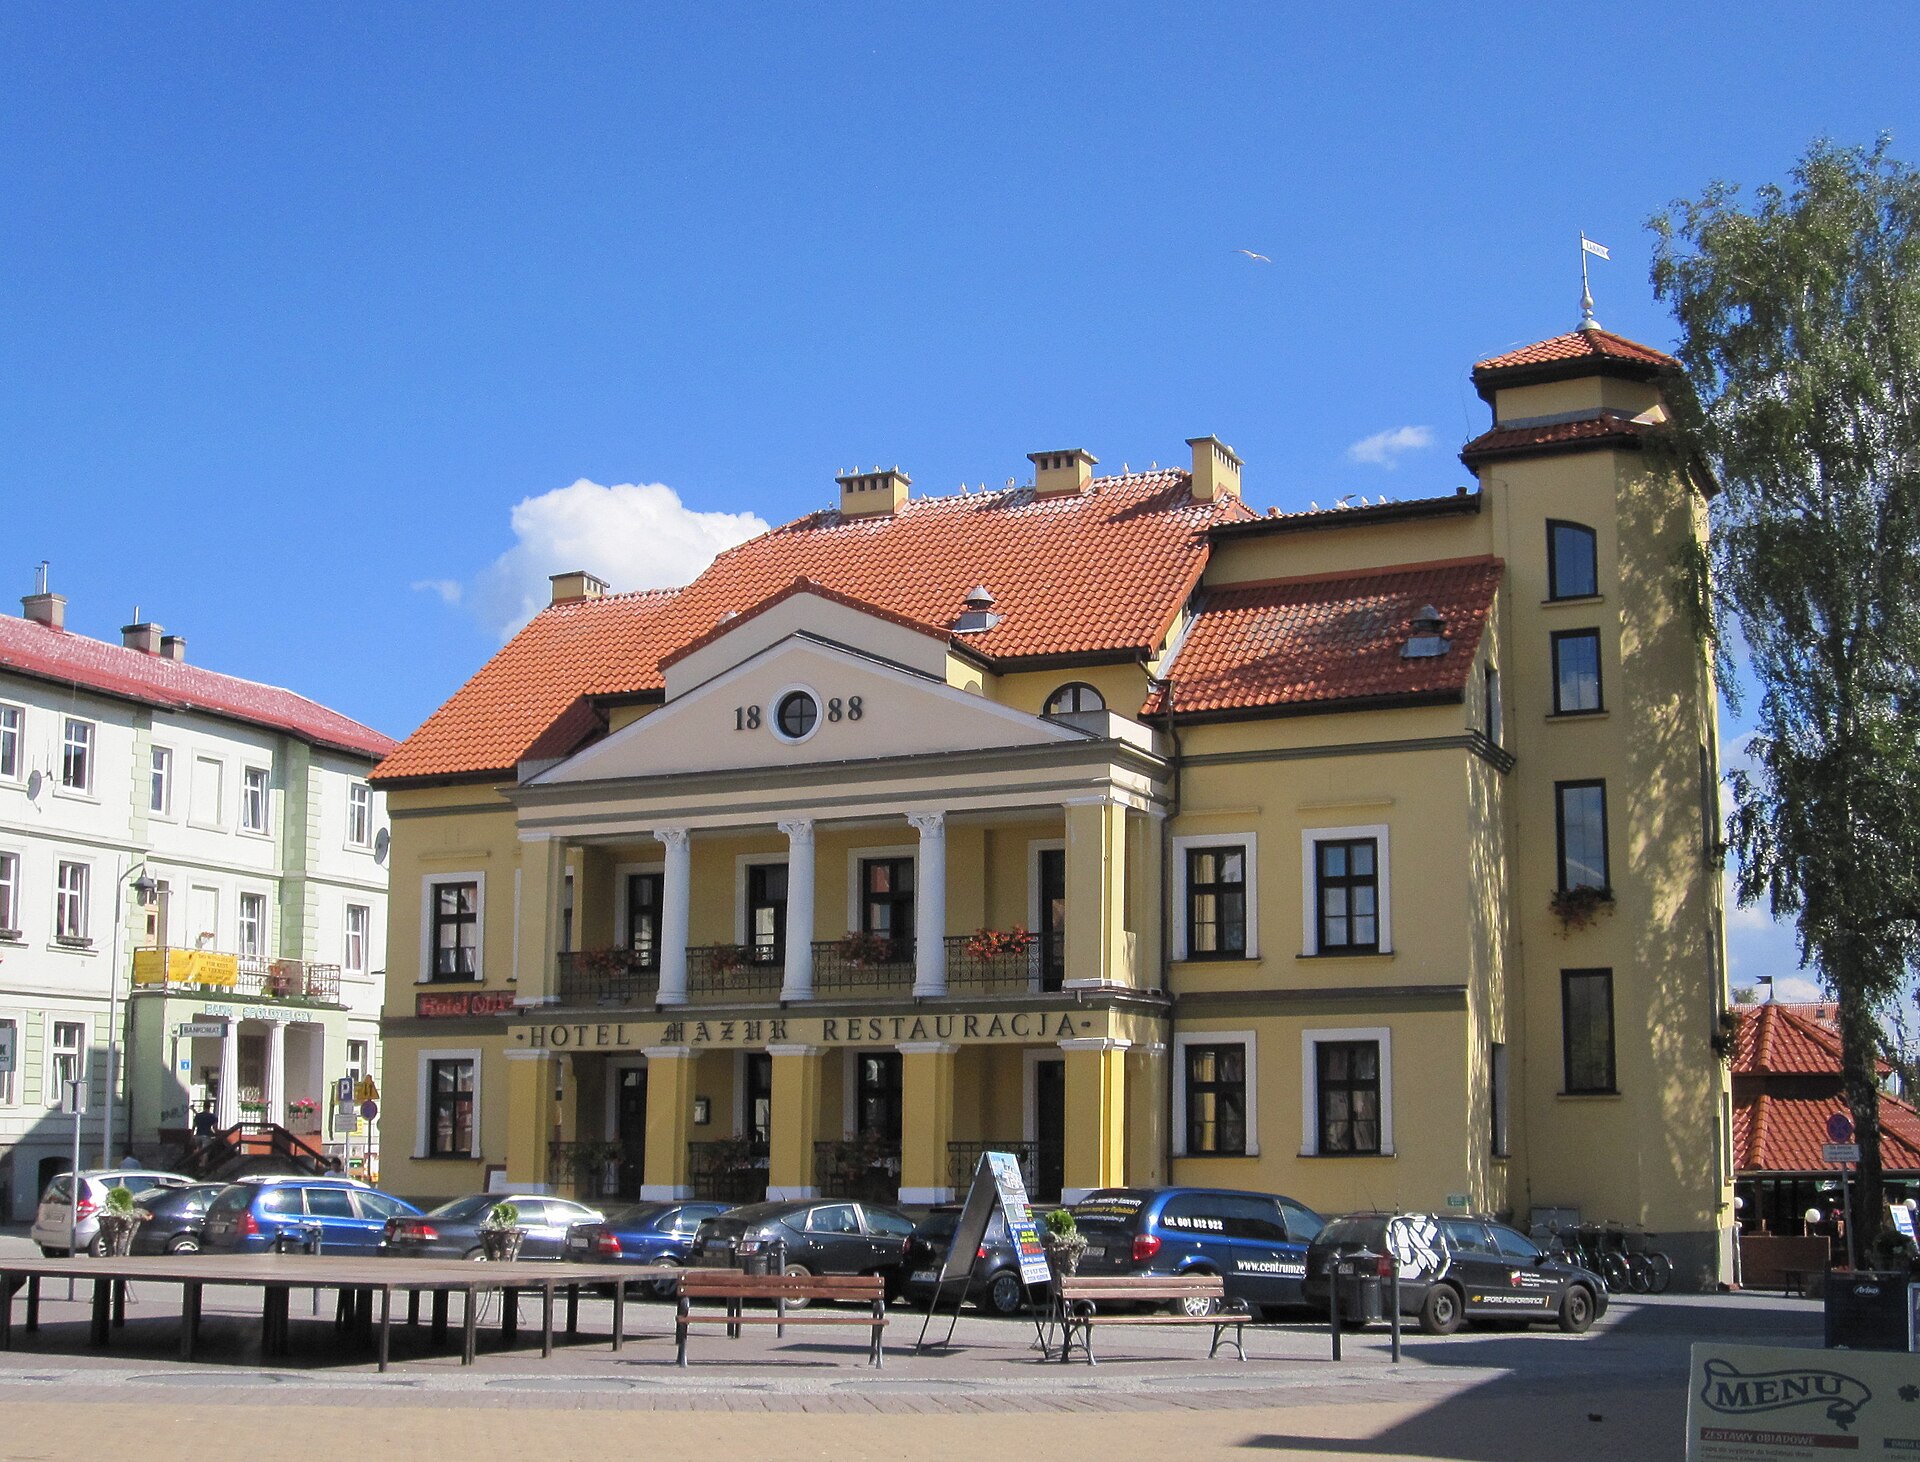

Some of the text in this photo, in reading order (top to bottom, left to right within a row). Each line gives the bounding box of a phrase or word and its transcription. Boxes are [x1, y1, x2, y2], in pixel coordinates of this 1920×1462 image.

[733, 695, 863, 731] 18 88
[205, 1004, 233, 1017] BANK
[183, 1025, 220, 1035] BANKOMAT
[529, 1013, 1077, 1047] HOTEL MAZUR RESTAURACJA
[341, 1080, 350, 1100] P
[1164, 1216, 1177, 1227] tel.
[1178, 1217, 1191, 1228] 601
[1193, 1218, 1207, 1229] 812
[1714, 1376, 1843, 1407] MENU
[1704, 1430, 1815, 1446] ZESTAWY OBIADOWE
